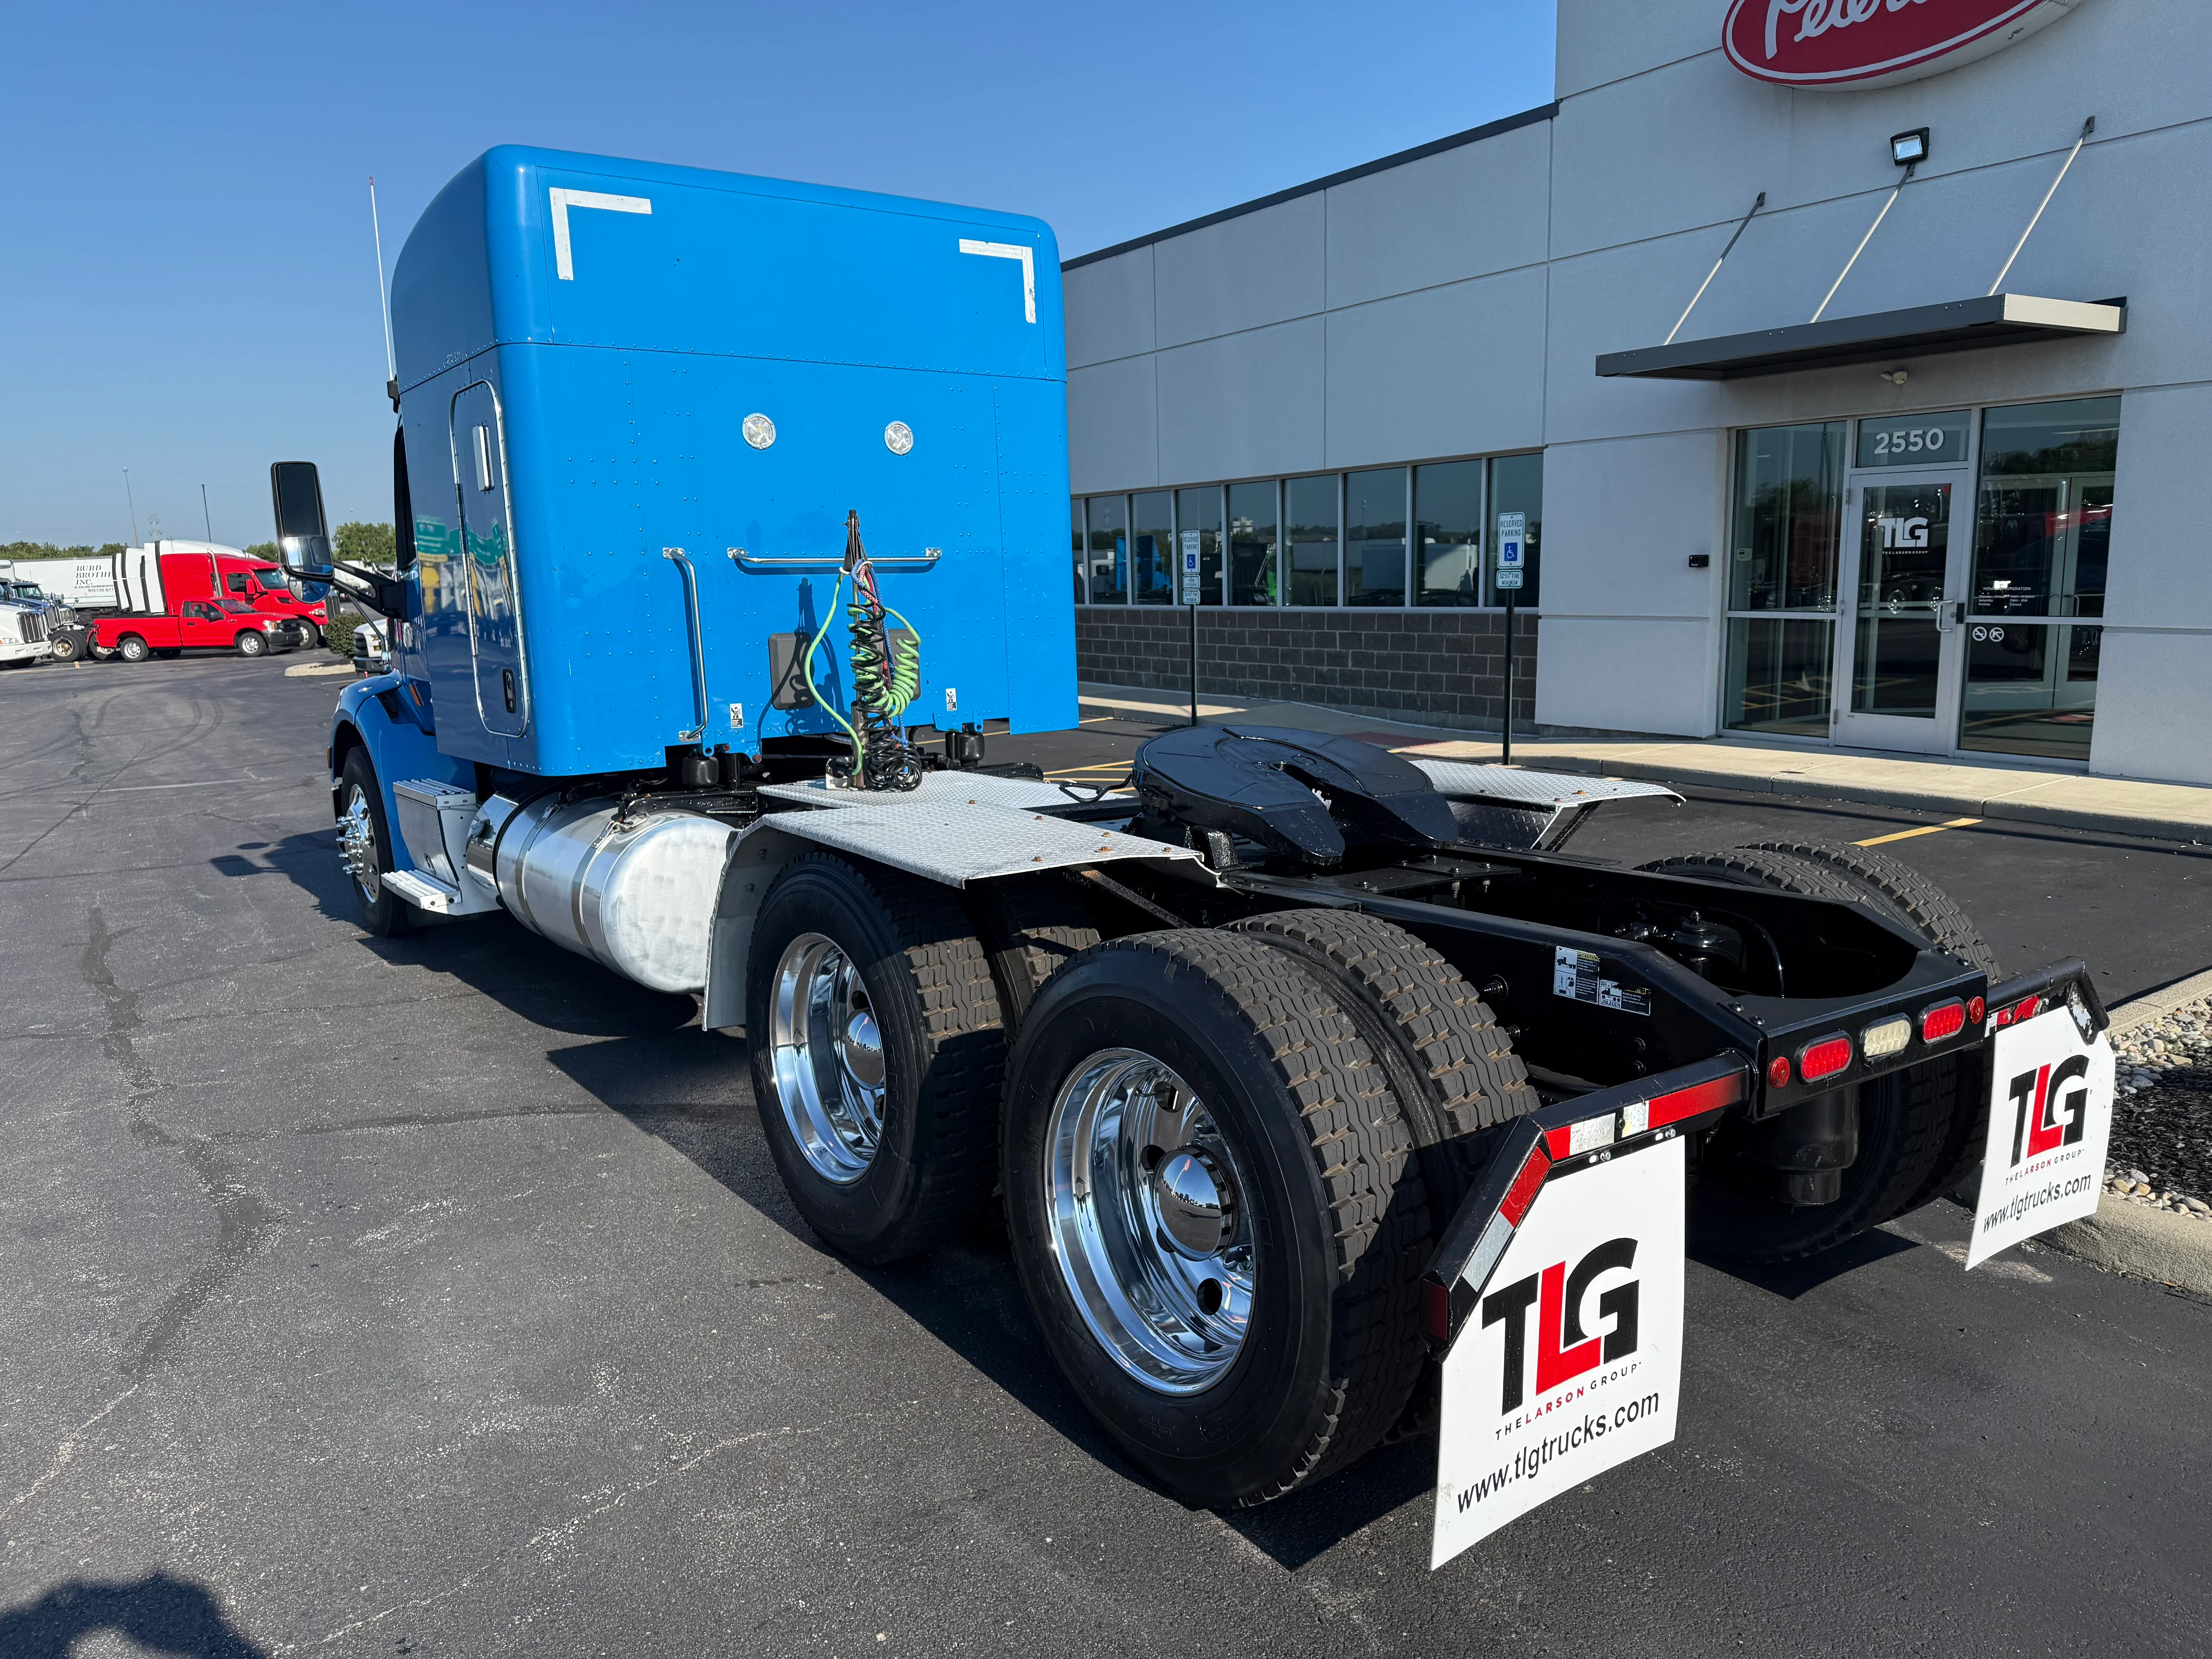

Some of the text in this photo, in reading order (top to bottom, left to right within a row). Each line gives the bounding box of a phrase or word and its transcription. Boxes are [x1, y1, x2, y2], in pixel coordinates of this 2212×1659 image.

[1874, 428, 1944, 453] 2550
[1878, 517, 1928, 548] TLG
[2009, 1054, 2090, 1168] TLG
[2020, 1159, 2051, 1178] LARSON
[2054, 1149, 2081, 1163] GROUP
[1984, 1174, 2091, 1234] www.tlgtrucks.com
[1482, 1238, 1639, 1417] TLG
[1525, 1386, 1585, 1424] LARSON
[1590, 1364, 1637, 1390] GROUP
[1458, 1393, 1659, 1514] www.tlgtrucks.com
